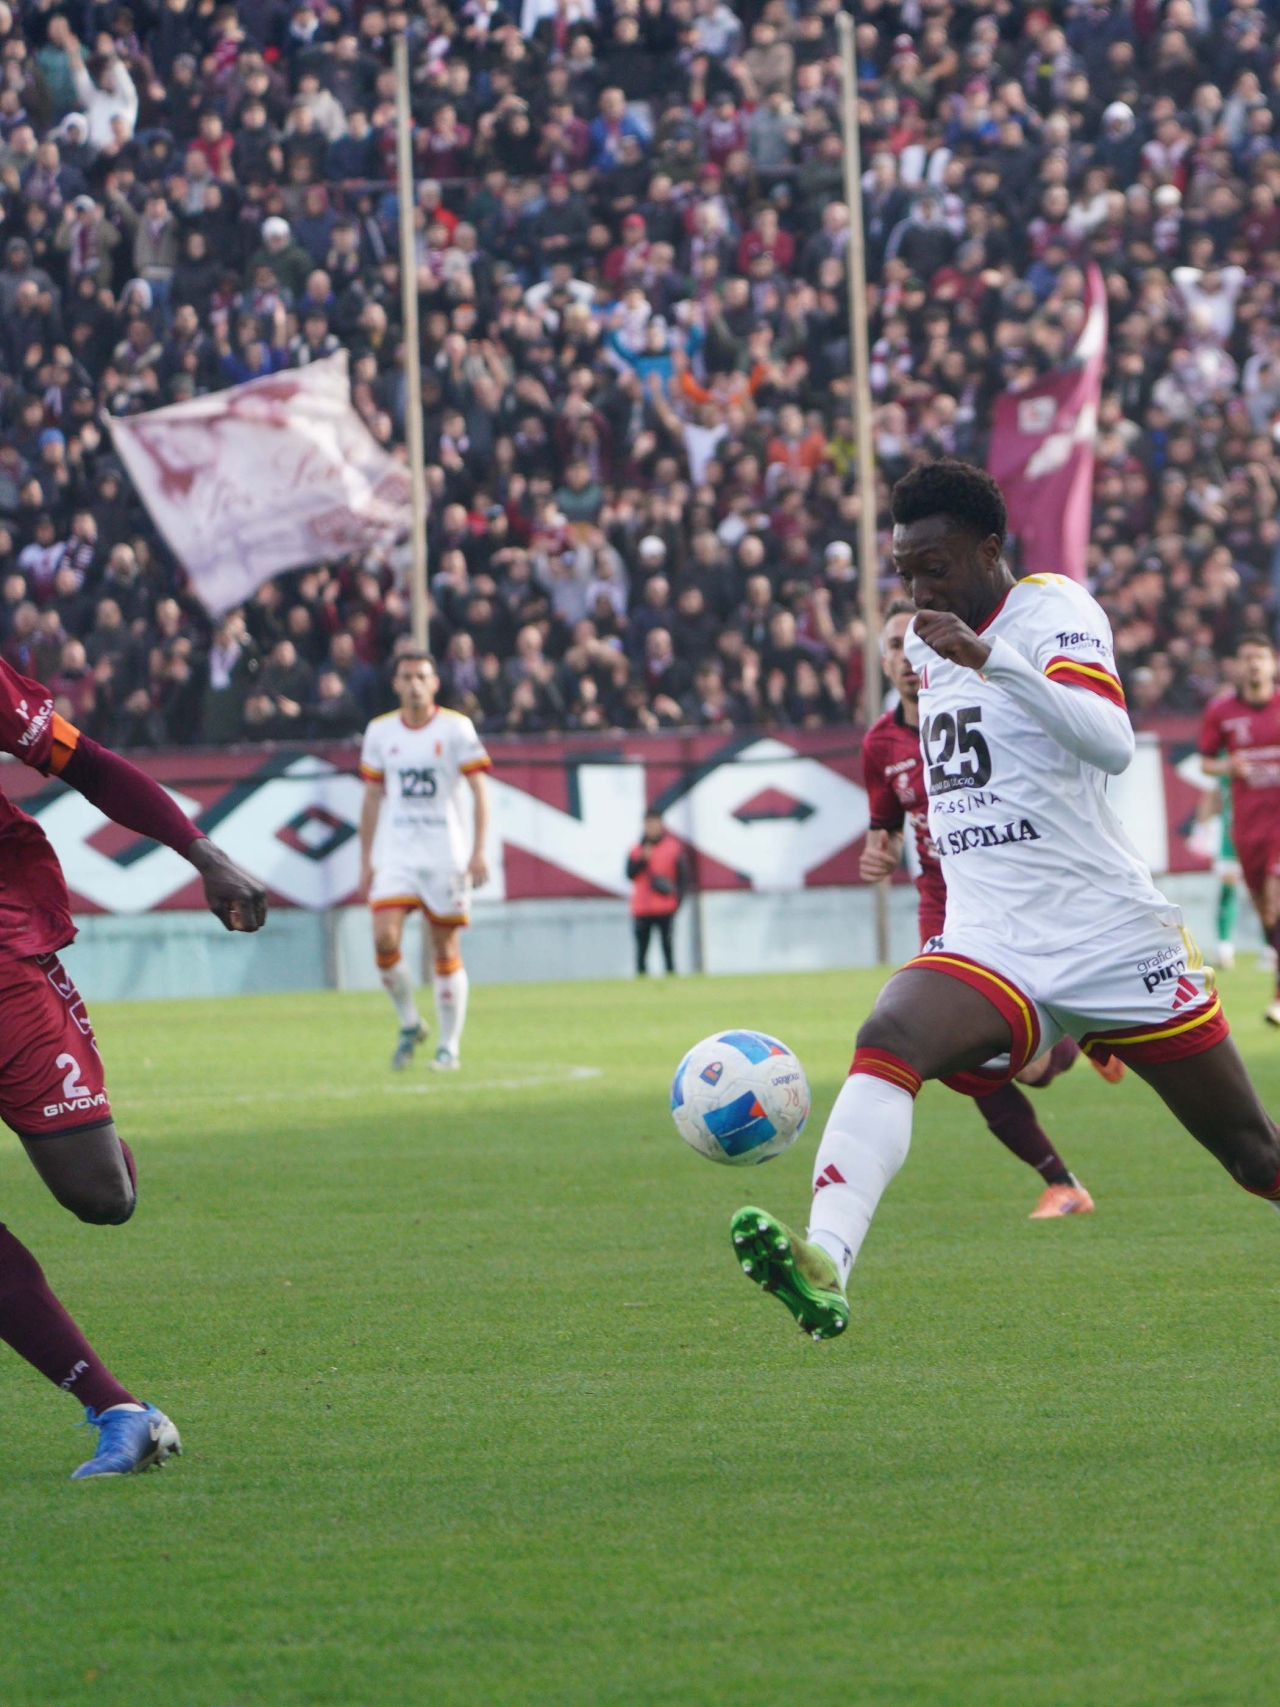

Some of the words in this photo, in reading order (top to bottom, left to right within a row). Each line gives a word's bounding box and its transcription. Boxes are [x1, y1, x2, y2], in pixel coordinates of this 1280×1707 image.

[920, 706, 992, 797] 125
[399, 768, 437, 799] 125
[948, 818, 1041, 856] SICILIA
[1137, 946, 1182, 975] grafiche
[55, 1053, 92, 1099] 2
[43, 1093, 107, 1117] GIVOVA
